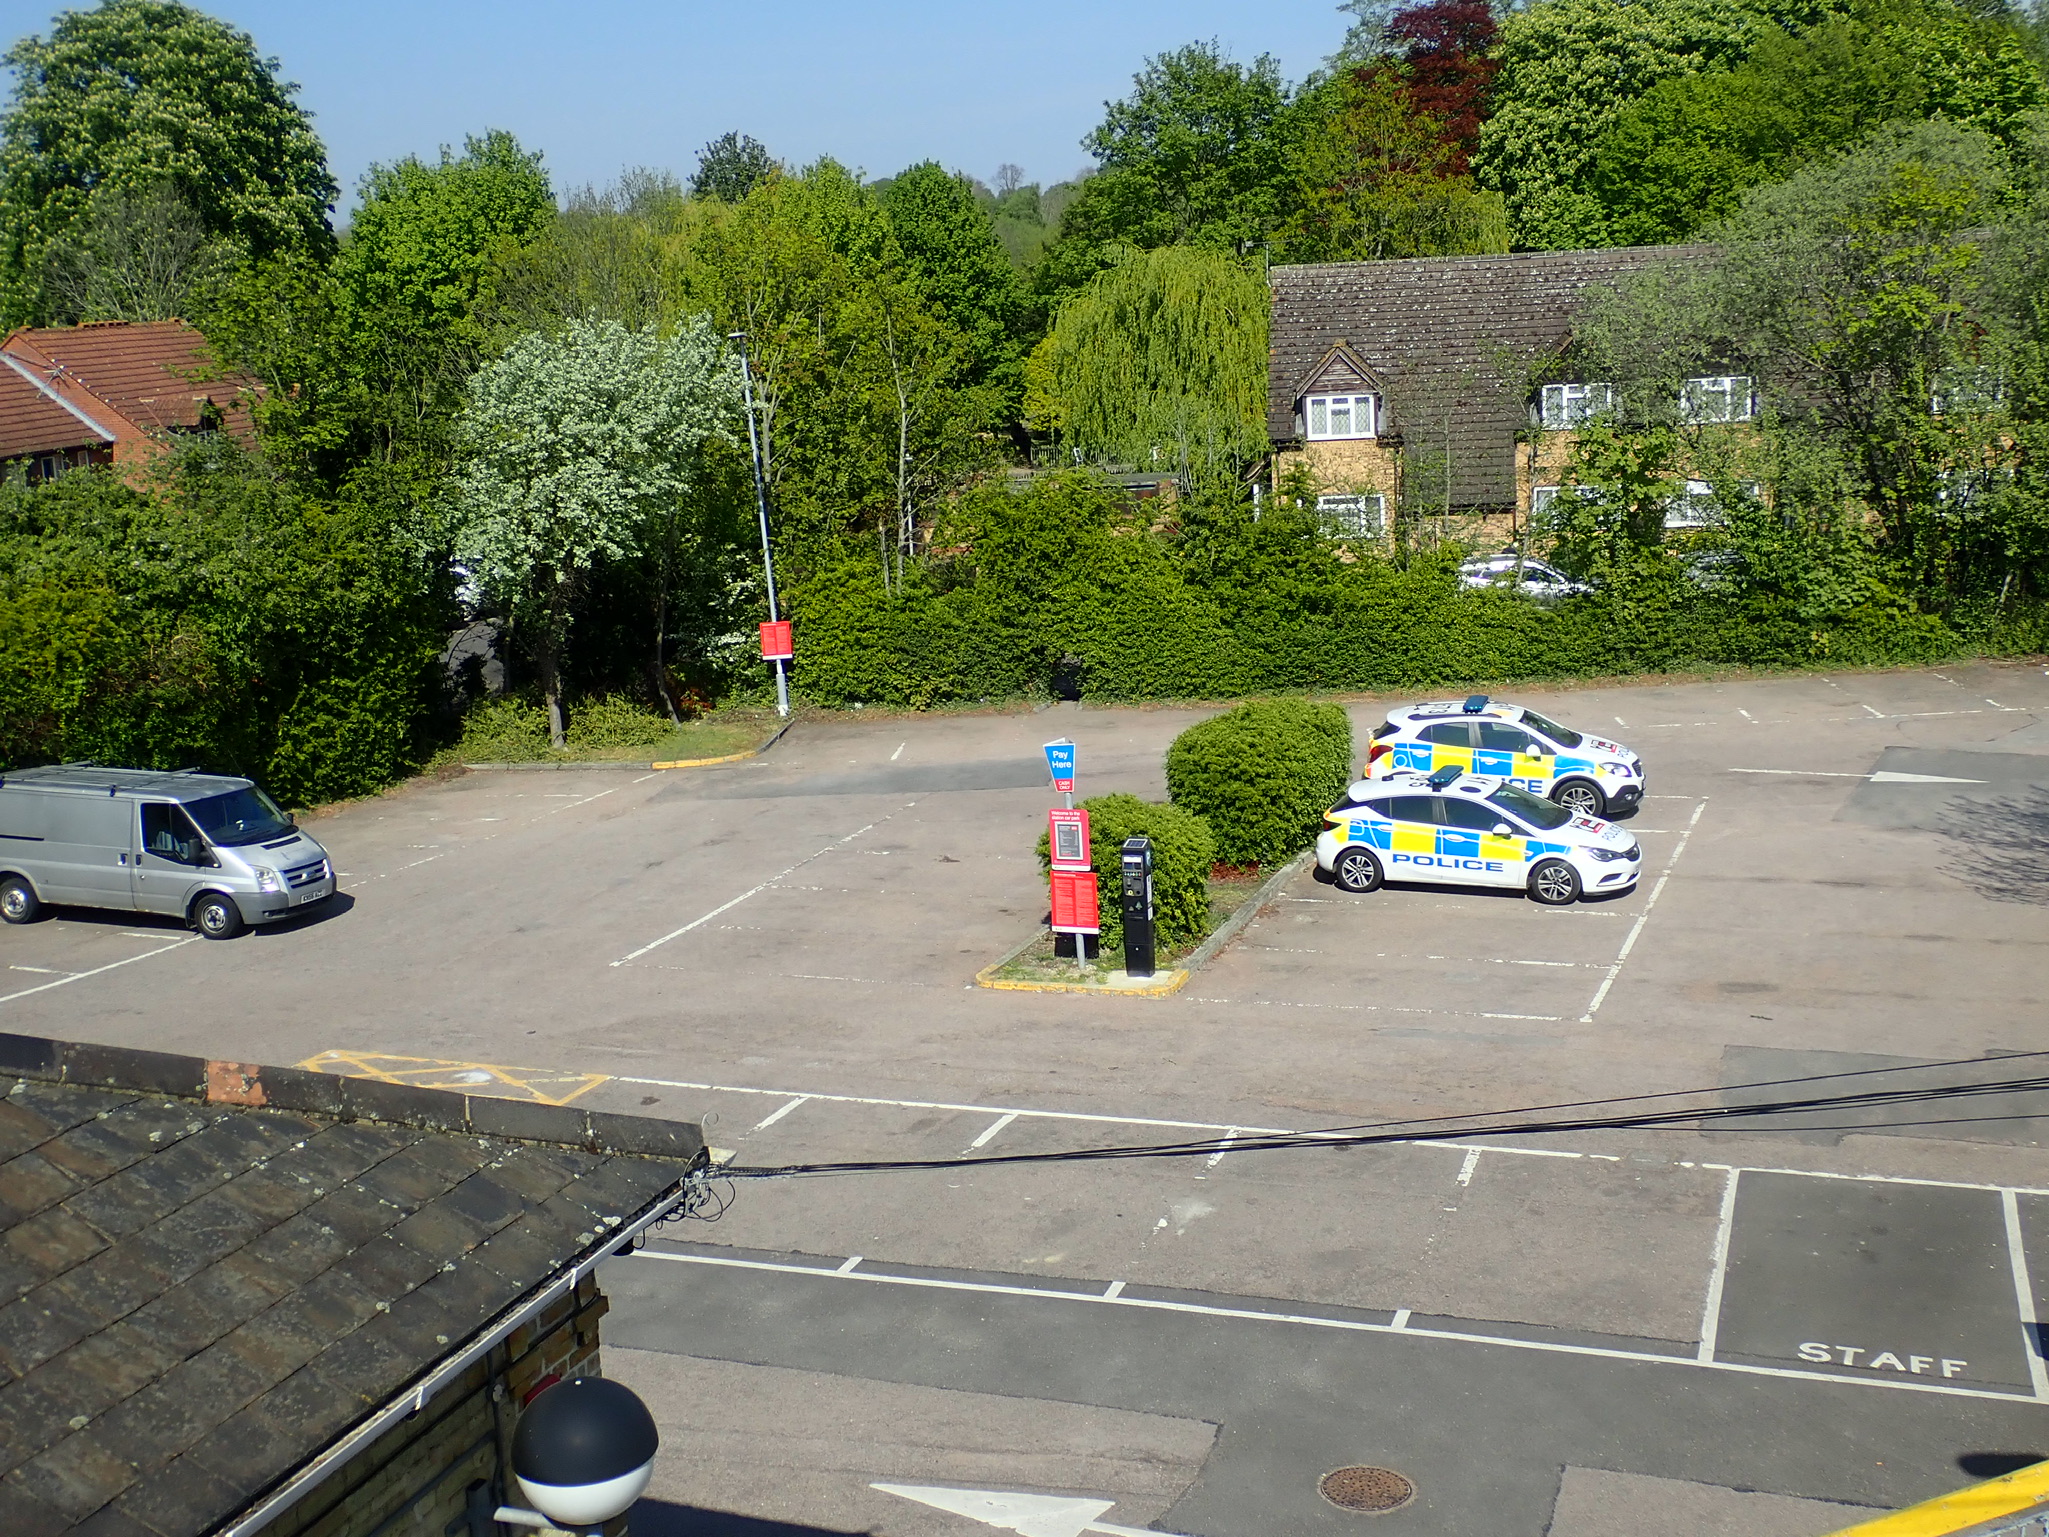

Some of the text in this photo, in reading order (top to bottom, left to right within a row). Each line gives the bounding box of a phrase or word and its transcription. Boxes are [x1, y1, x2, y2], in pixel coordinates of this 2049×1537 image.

[1052, 751, 1068, 760] Pay
[1052, 761, 1072, 769] Here
[1393, 853, 1503, 872] POLICE
[1797, 1342, 1968, 1378] STAFF
